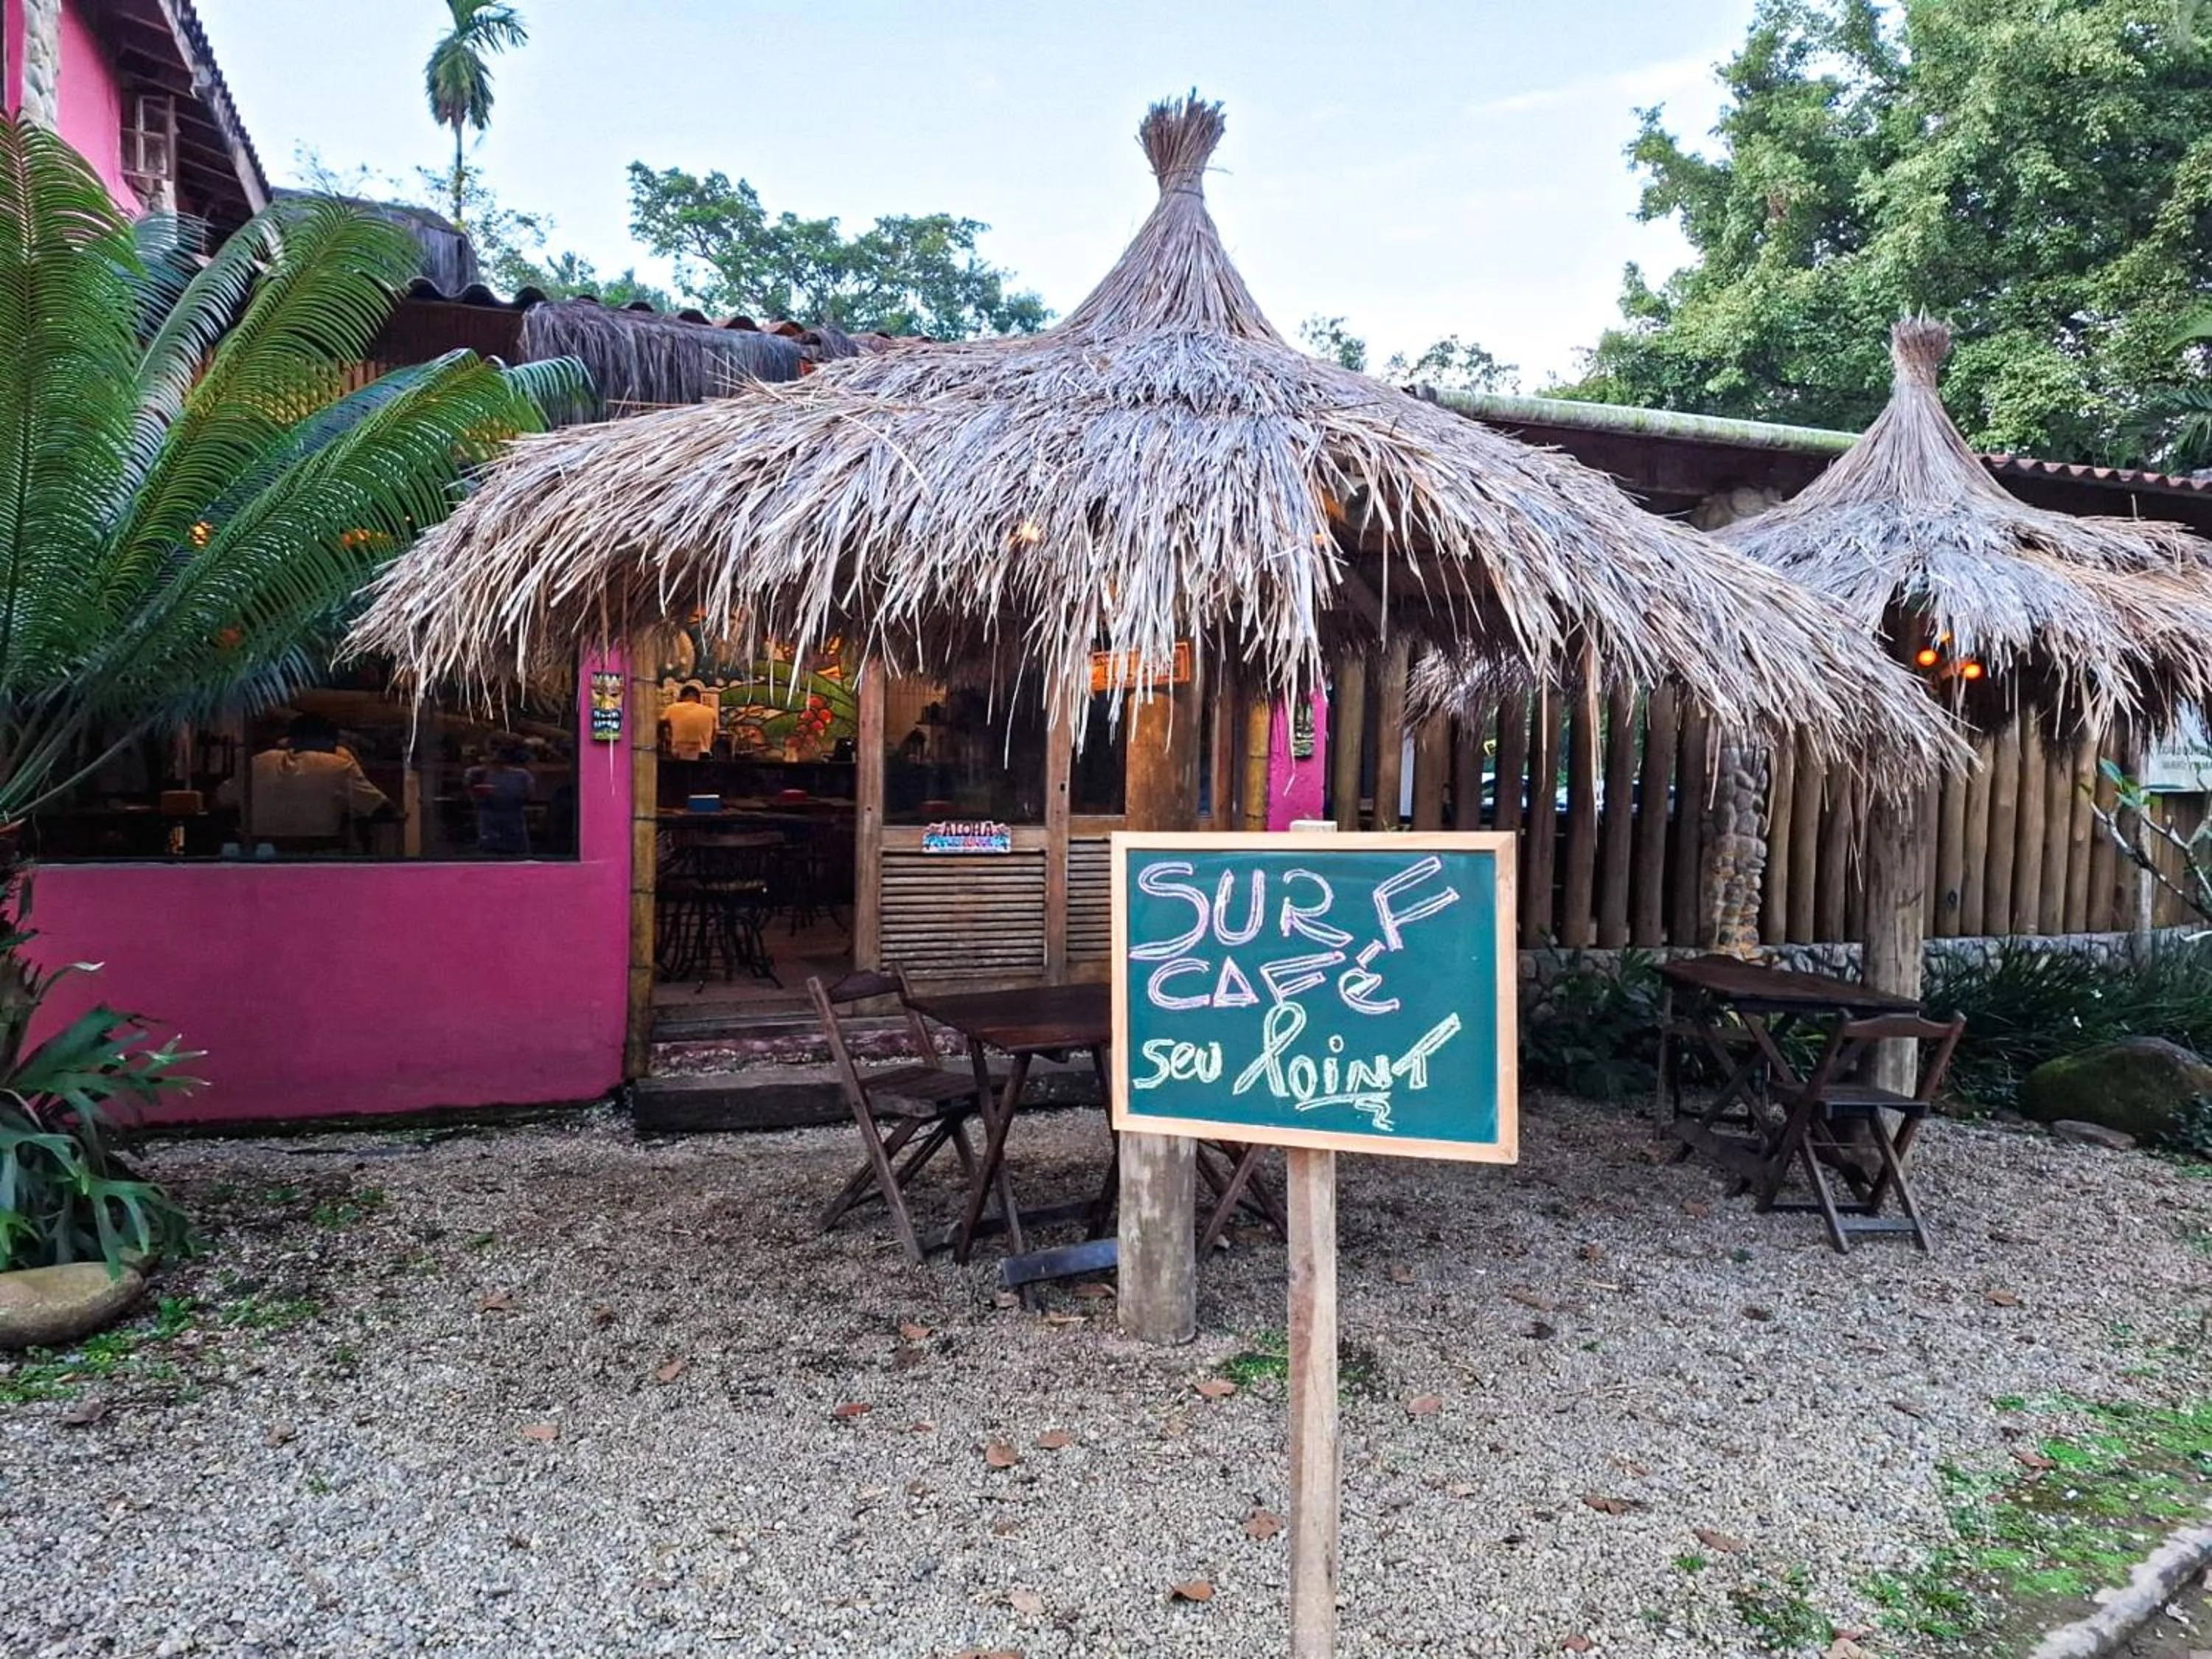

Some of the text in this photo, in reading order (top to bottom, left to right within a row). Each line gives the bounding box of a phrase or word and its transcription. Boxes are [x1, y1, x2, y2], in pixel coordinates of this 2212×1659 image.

[942, 821, 994, 837] ALOHA
[1128, 855, 1461, 959] SURF
[1133, 1037, 1223, 1090] seu
